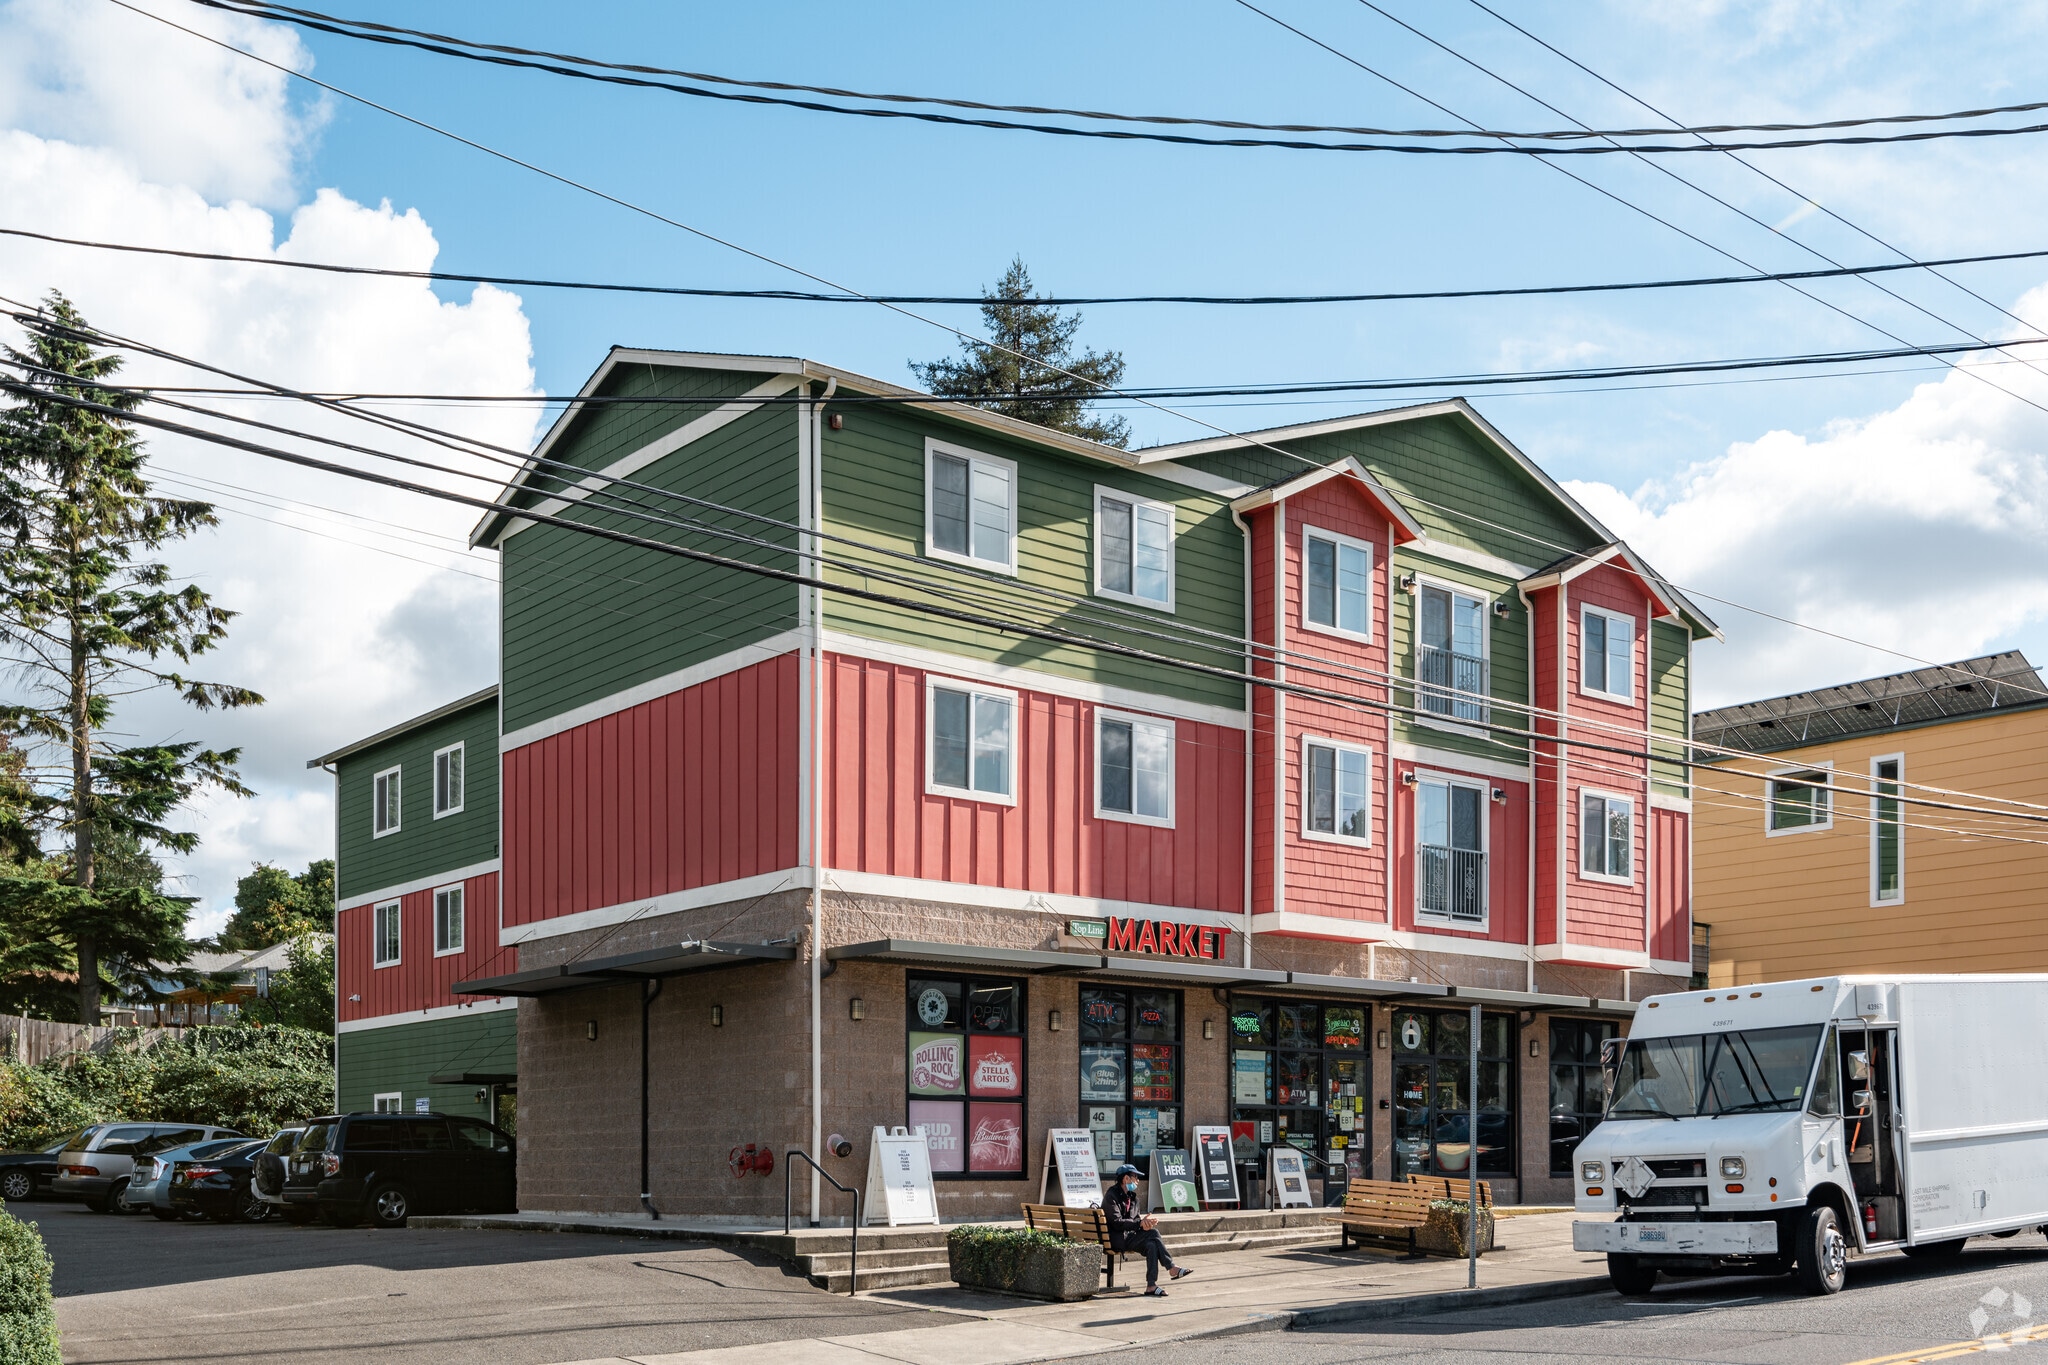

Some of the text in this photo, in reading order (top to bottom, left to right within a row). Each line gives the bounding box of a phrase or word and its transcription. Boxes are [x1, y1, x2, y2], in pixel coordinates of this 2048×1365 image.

[1072, 922, 1104, 935] Top Line
[1106, 915, 1232, 960] MARKET
[974, 1005, 1009, 1020] OPEN
[1088, 1003, 1113, 1018] ATM
[1142, 1011, 1160, 1021] PIZZA
[1231, 1016, 1258, 1025] PASSPORT
[1236, 1024, 1260, 1032] PHOTOS
[916, 1046, 954, 1065] ROLLING
[930, 1062, 954, 1078] ROCK
[981, 1066, 1009, 1075] STELLA
[1096, 1070, 1115, 1078] Blue
[981, 1074, 1010, 1083] ARTOIS
[1290, 1089, 1306, 1097] ATM
[1403, 1090, 1423, 1099] HOME
[1092, 1112, 1105, 1122] 4G
[1341, 1116, 1353, 1125] EBT
[920, 1123, 952, 1137] BUD
[977, 1130, 1016, 1141] Budweiser
[926, 1136, 957, 1150] GHT
[1162, 1154, 1184, 1165] PLAY
[1163, 1165, 1187, 1176] HERE
[1912, 1184, 1951, 1195] LAST MILE SHIPPING
[1912, 1192, 1940, 1203] CORPORATION
